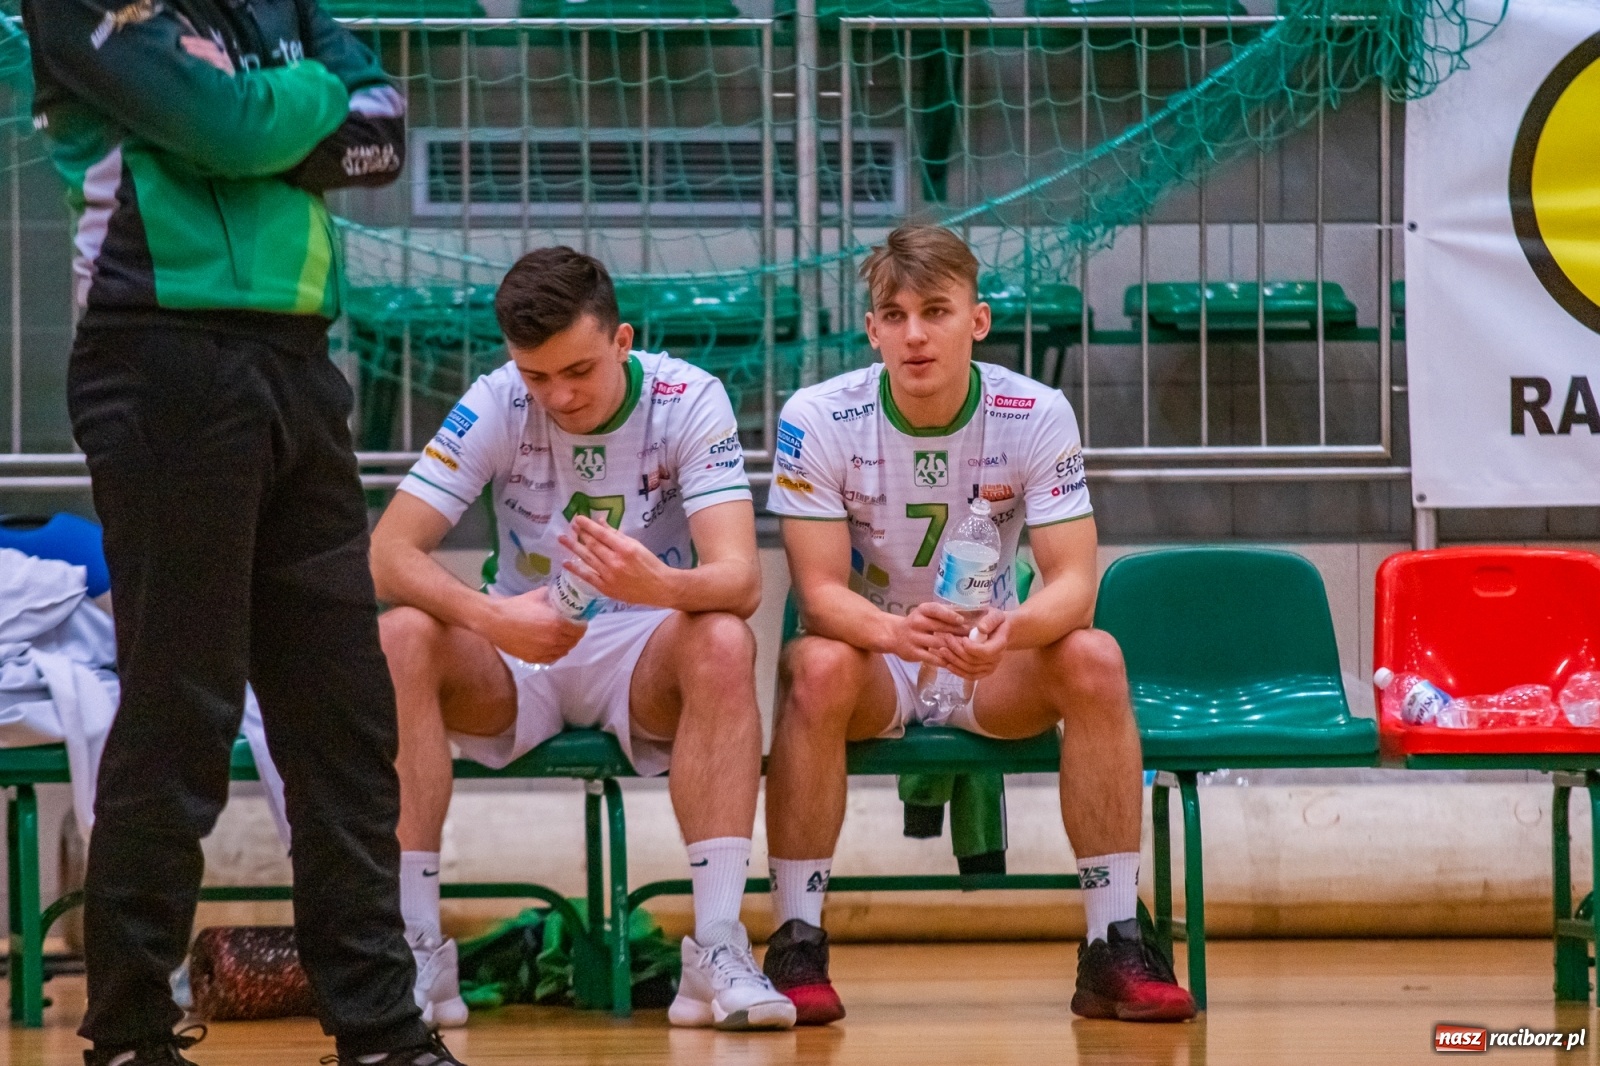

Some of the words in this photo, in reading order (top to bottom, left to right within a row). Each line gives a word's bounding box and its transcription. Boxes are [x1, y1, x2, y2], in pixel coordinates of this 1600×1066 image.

[996, 398, 1033, 408] OMEGA
[832, 402, 875, 421] CUTLIN
[984, 409, 1030, 420] ransport
[906, 502, 949, 568] 7
